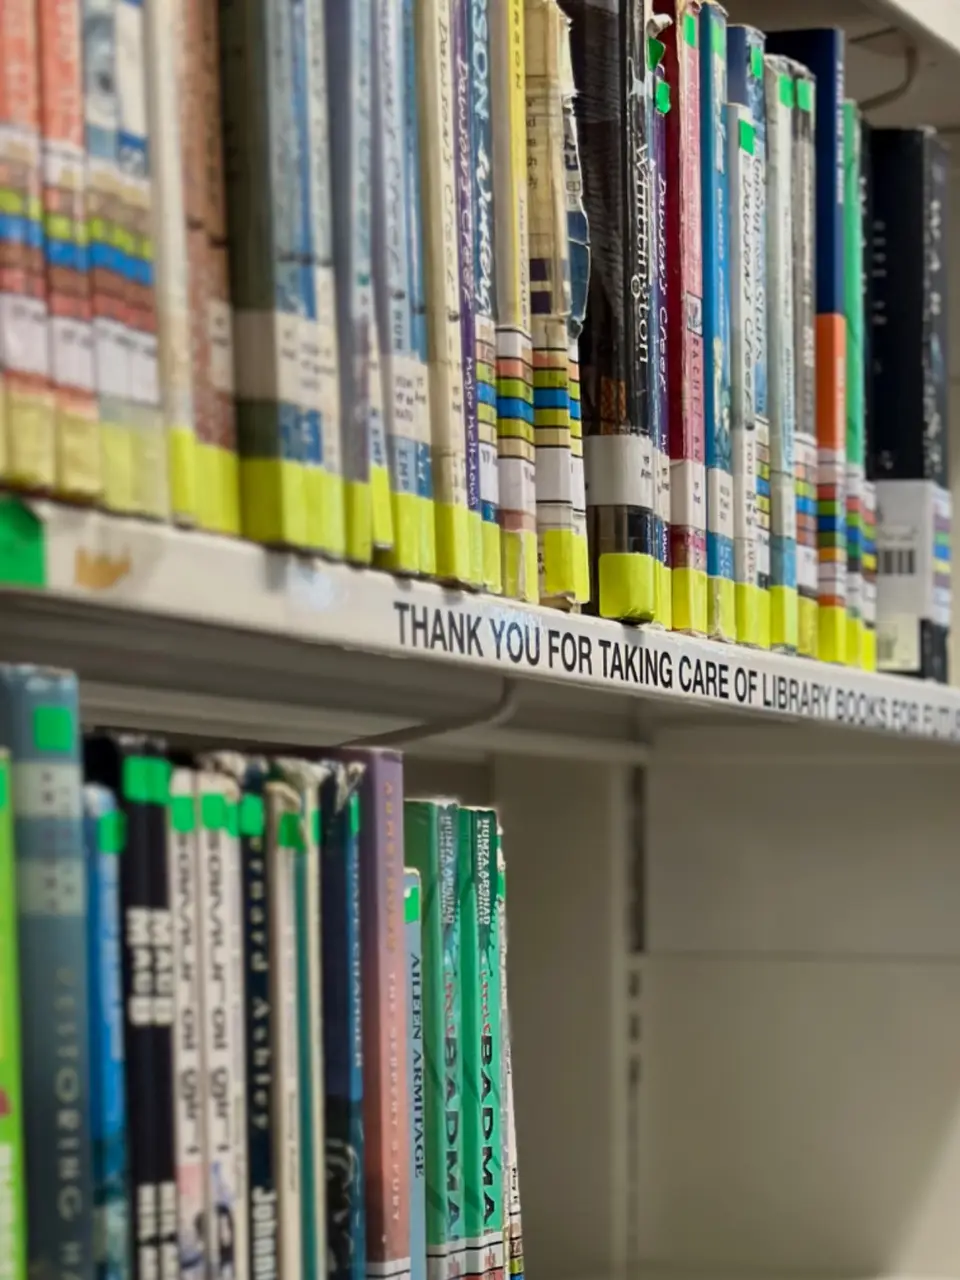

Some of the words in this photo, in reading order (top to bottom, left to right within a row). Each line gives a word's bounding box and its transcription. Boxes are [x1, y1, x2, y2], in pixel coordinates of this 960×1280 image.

[393, 602, 485, 657] THANK
[488, 617, 541, 666] YOU
[548, 629, 593, 675] FOR
[597, 638, 673, 689] TAKING
[677, 655, 729, 699] CARE
[735, 666, 758, 703] OF
[763, 672, 831, 719] LIBRARY
[834, 687, 887, 726] BOOKS
[890, 697, 920, 733] FOR
[482, 818, 492, 865] HUMZA
[482, 871, 493, 926] ARSHAD
[410, 953, 423, 1041] AILEEN
[252, 997, 273, 1130] Ashley
[413, 1048, 426, 1179] ARMITAGE
